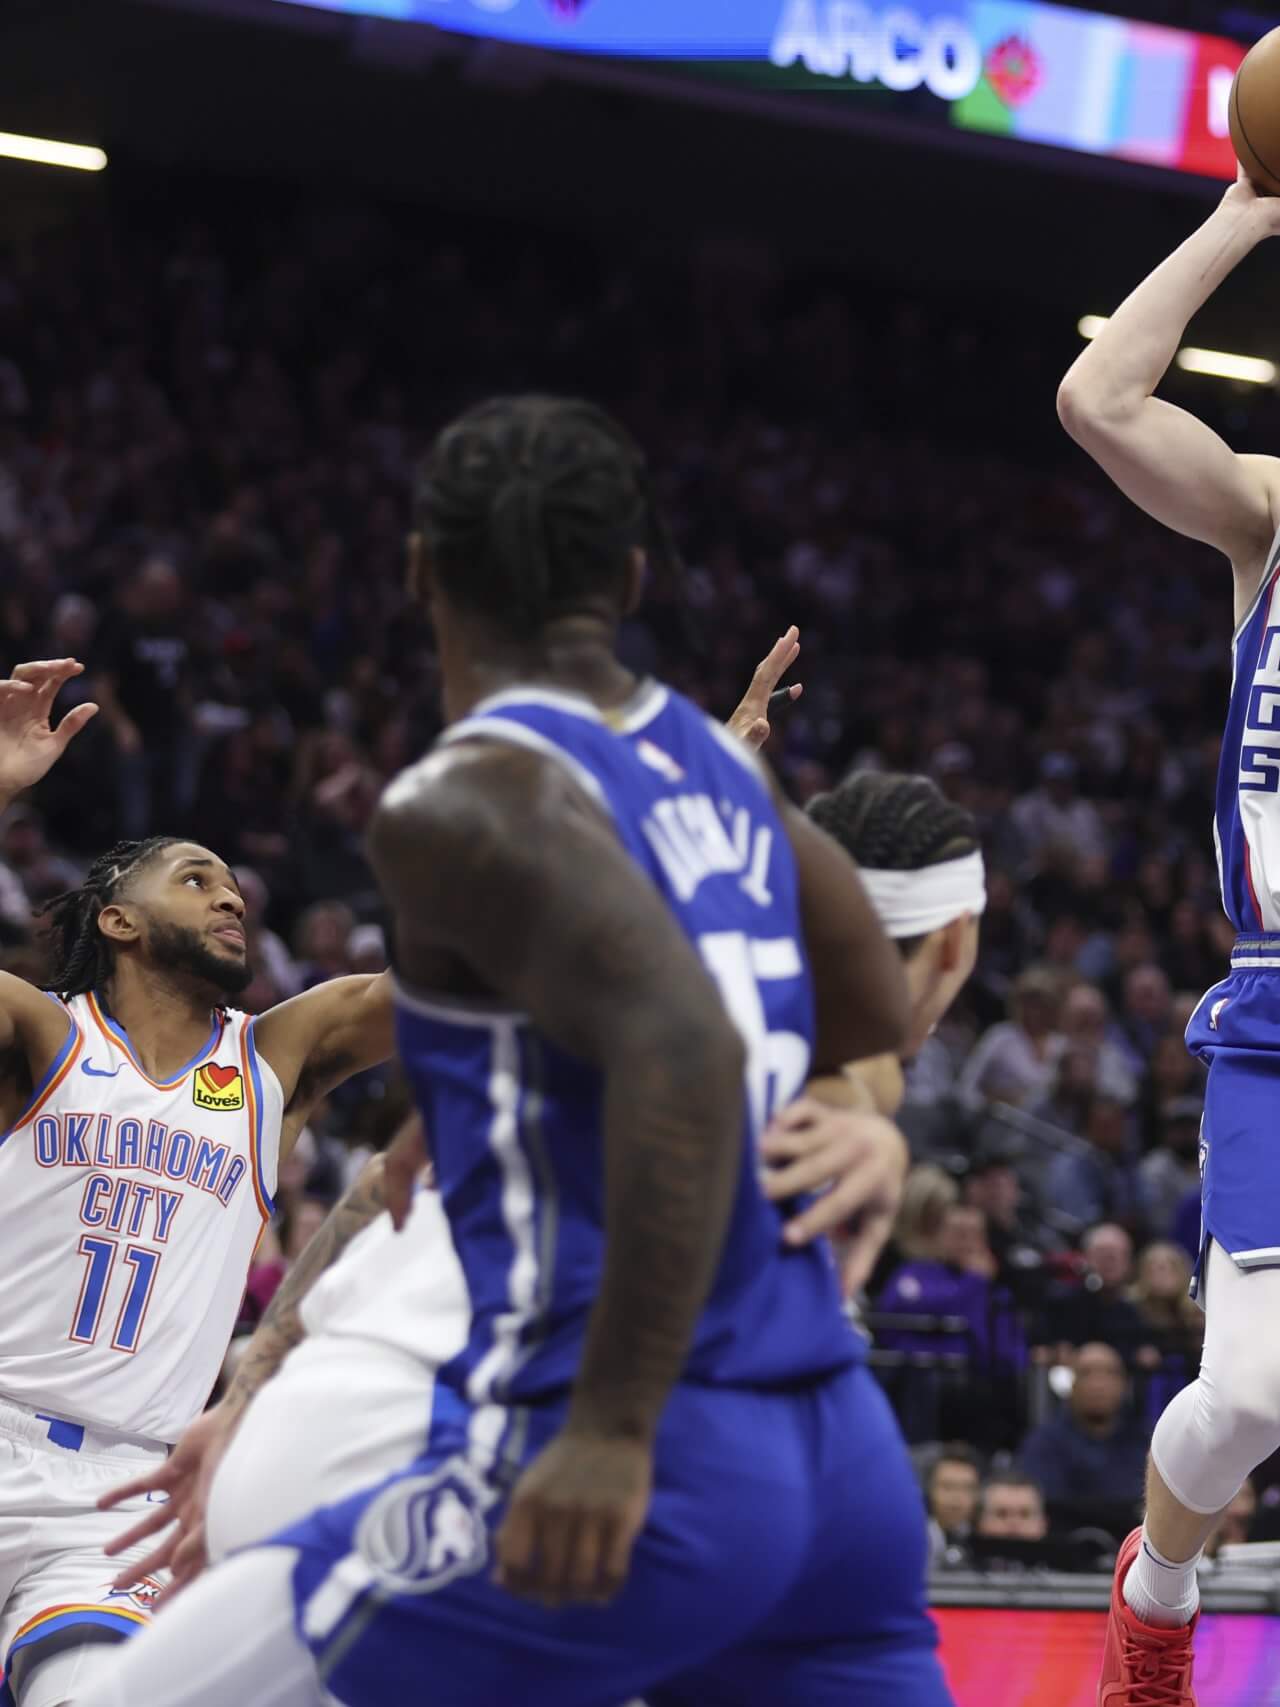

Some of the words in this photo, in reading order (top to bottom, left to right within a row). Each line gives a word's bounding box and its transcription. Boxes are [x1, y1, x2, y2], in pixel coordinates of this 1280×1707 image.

[769, 0, 982, 100] ARCO
[34, 1112, 247, 1207] OKLAHOMA
[79, 1172, 183, 1244] CITY
[69, 1234, 161, 1354] 11
